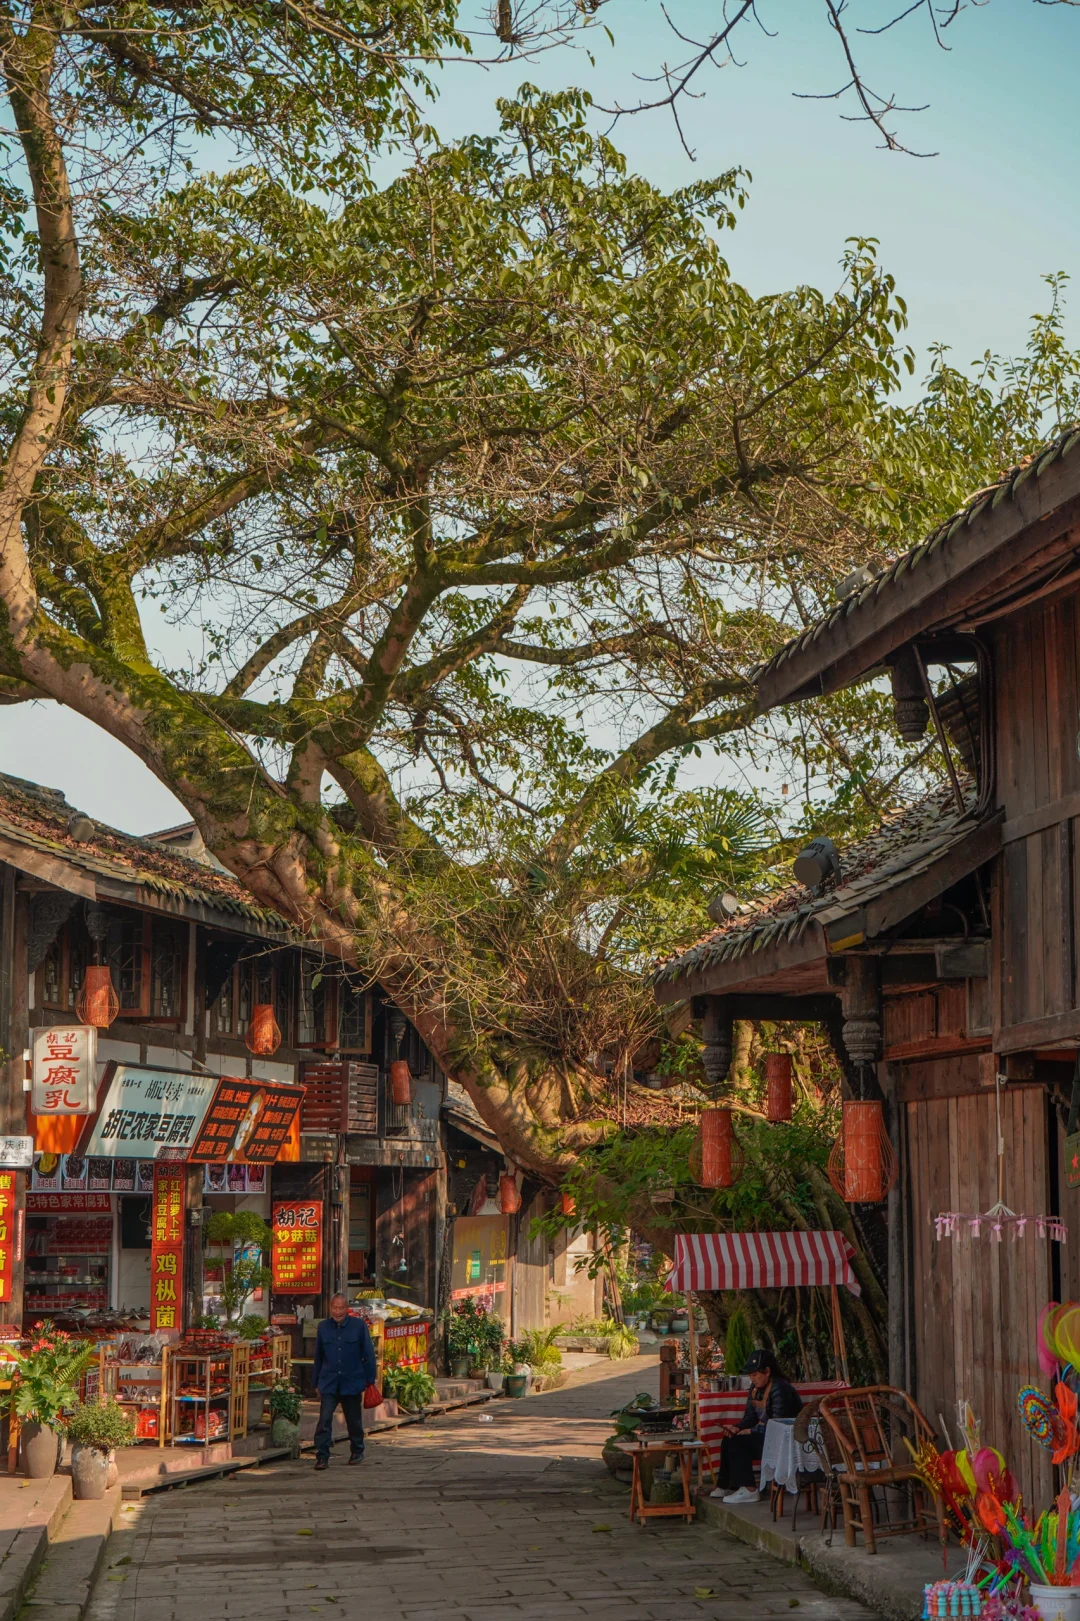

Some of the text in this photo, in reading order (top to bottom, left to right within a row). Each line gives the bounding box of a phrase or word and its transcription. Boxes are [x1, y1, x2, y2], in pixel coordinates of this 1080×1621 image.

[42, 1045, 81, 1109] 豆腐乳
[144, 1080, 184, 1101] 胡记专卖
[101, 1109, 196, 1143] 胡记农家豆腐乳
[158, 1165, 182, 1177] 胡记
[156, 1179, 168, 1241] 家常豆腐乳
[169, 1179, 181, 1241] 红油萝卜干
[276, 1206, 319, 1228] 胡记
[155, 1252, 178, 1329] 鸡枞菌
